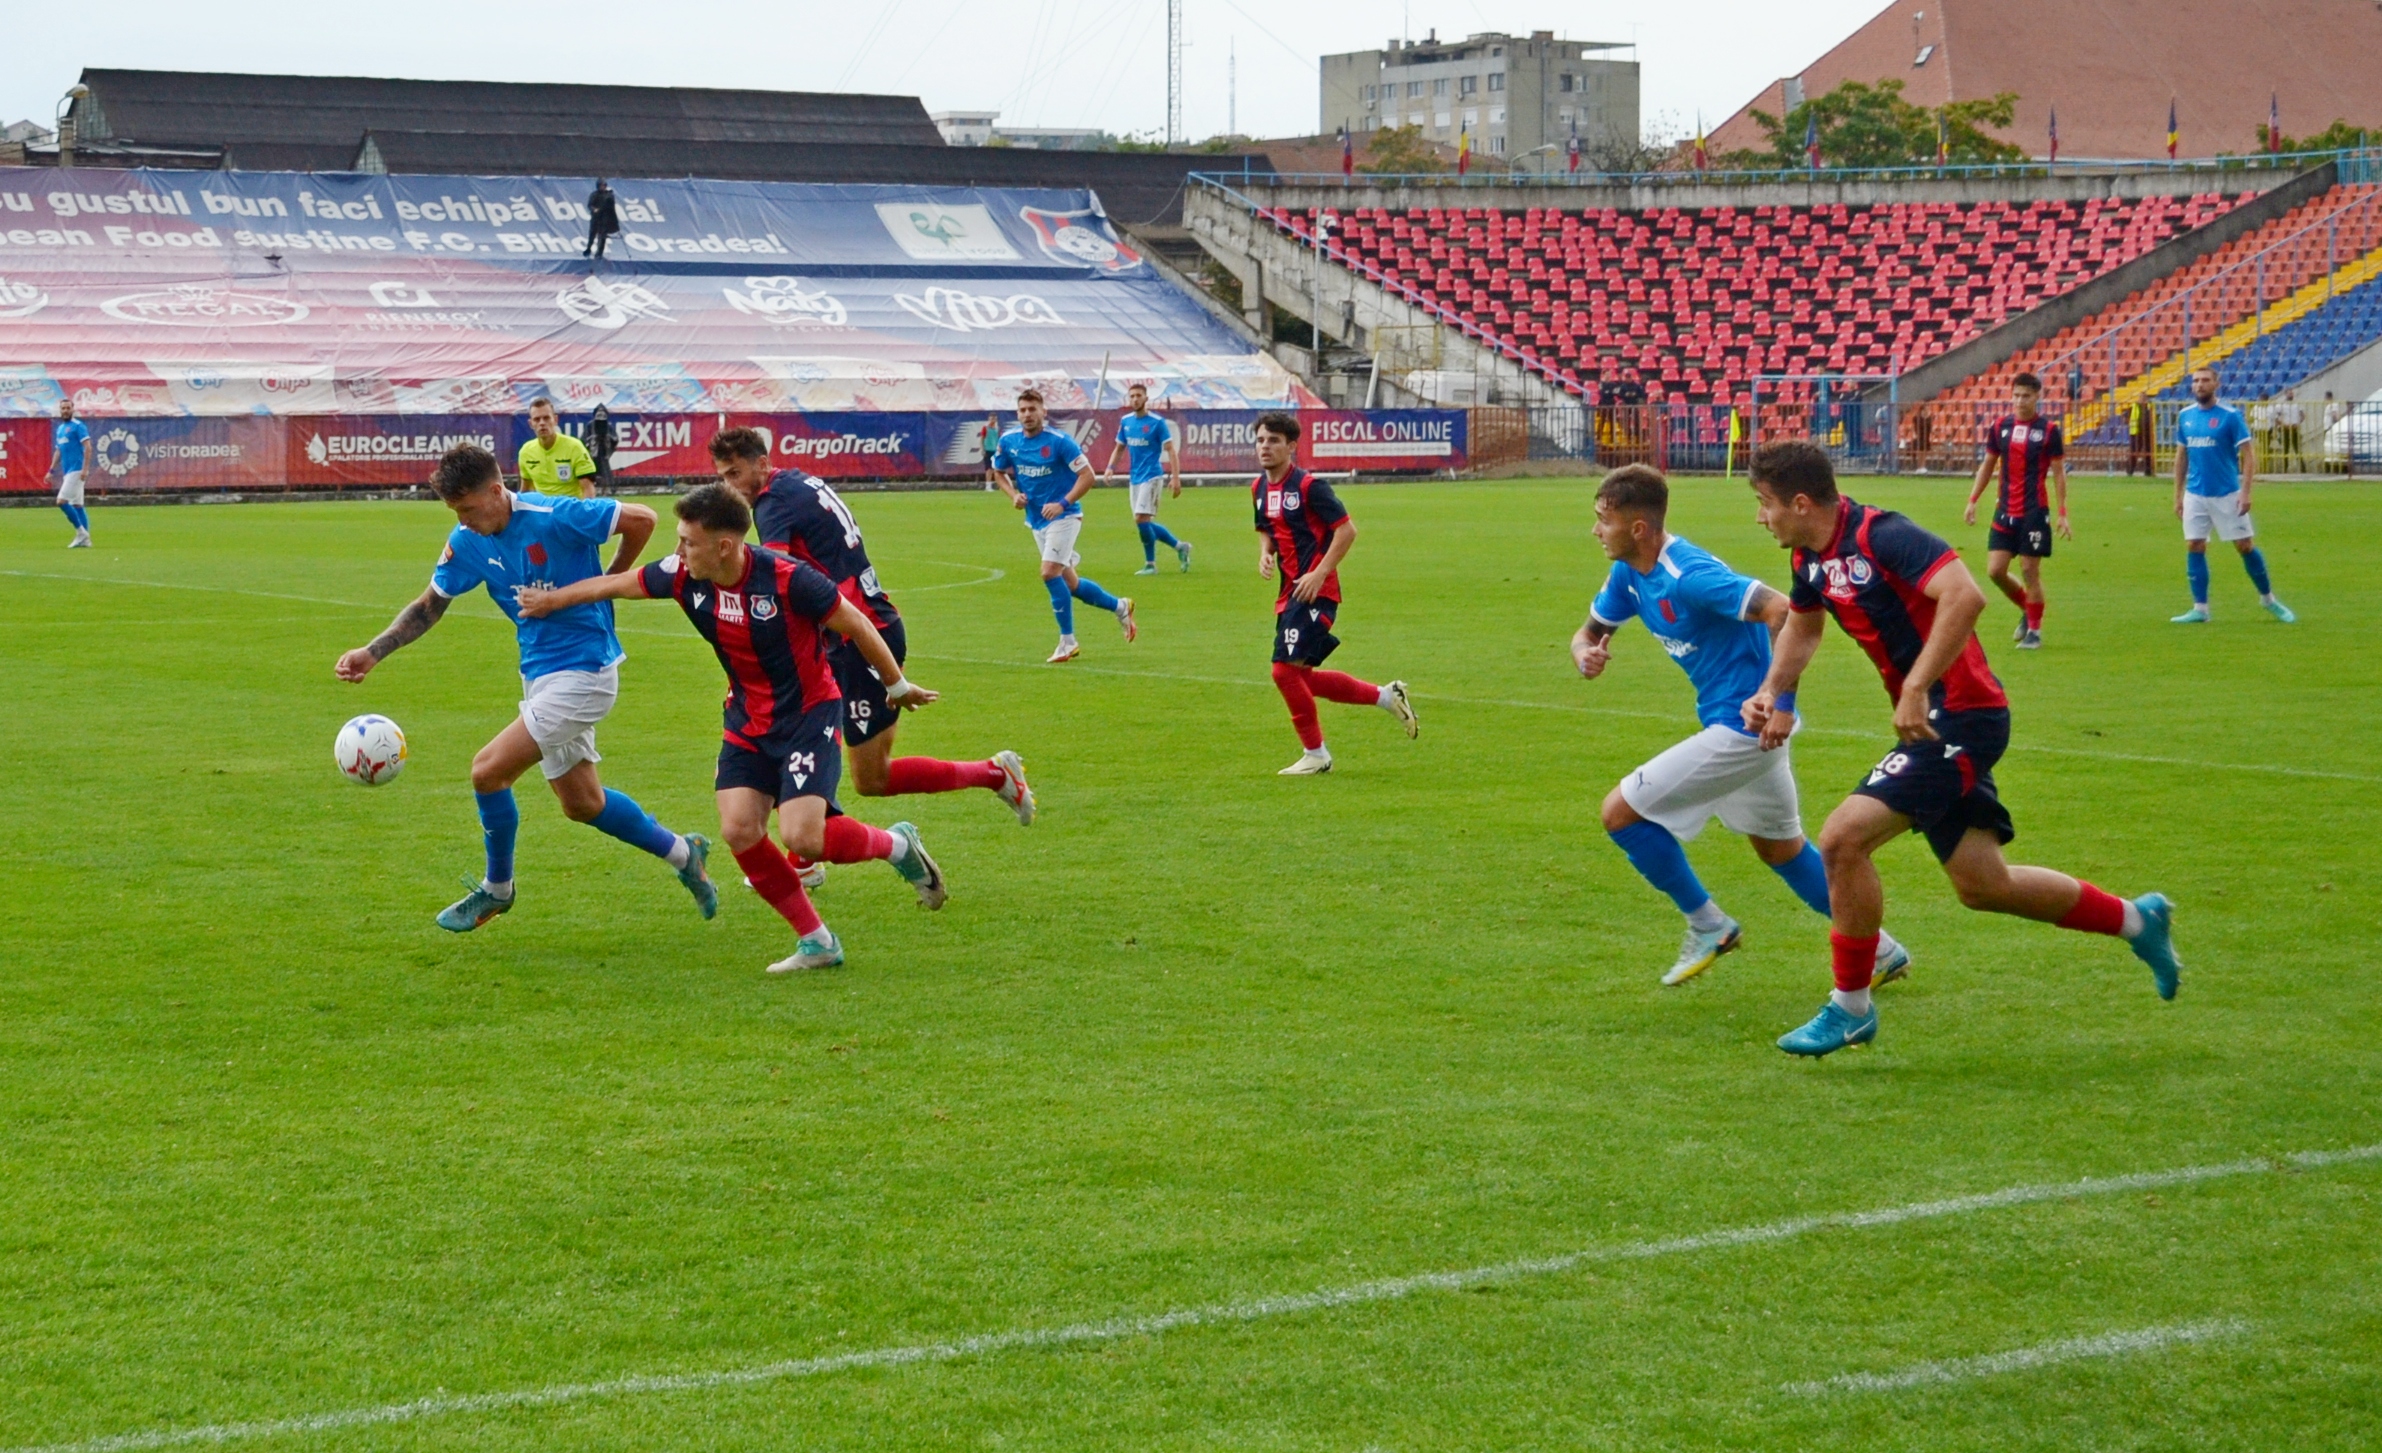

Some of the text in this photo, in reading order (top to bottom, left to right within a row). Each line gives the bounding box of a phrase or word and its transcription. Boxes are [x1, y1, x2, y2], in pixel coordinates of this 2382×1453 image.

[0, 191, 35, 213] u
[47, 189, 192, 217] gustul
[200, 190, 288, 217] bun
[298, 190, 384, 221] faci
[397, 196, 540, 227] echipă
[103, 226, 223, 249] Food
[405, 230, 490, 252] F.C.
[624, 232, 789, 255] Oradea!
[133, 301, 286, 316] REGAL
[364, 312, 482, 322] RIENERGY
[1312, 420, 1453, 442] FISCAL ONLINE
[328, 435, 496, 455] EUROCLEANING
[779, 432, 902, 459] CargoTrack
[1284, 627, 1299, 644] 19
[849, 699, 872, 719] 16
[788, 751, 816, 773] 24
